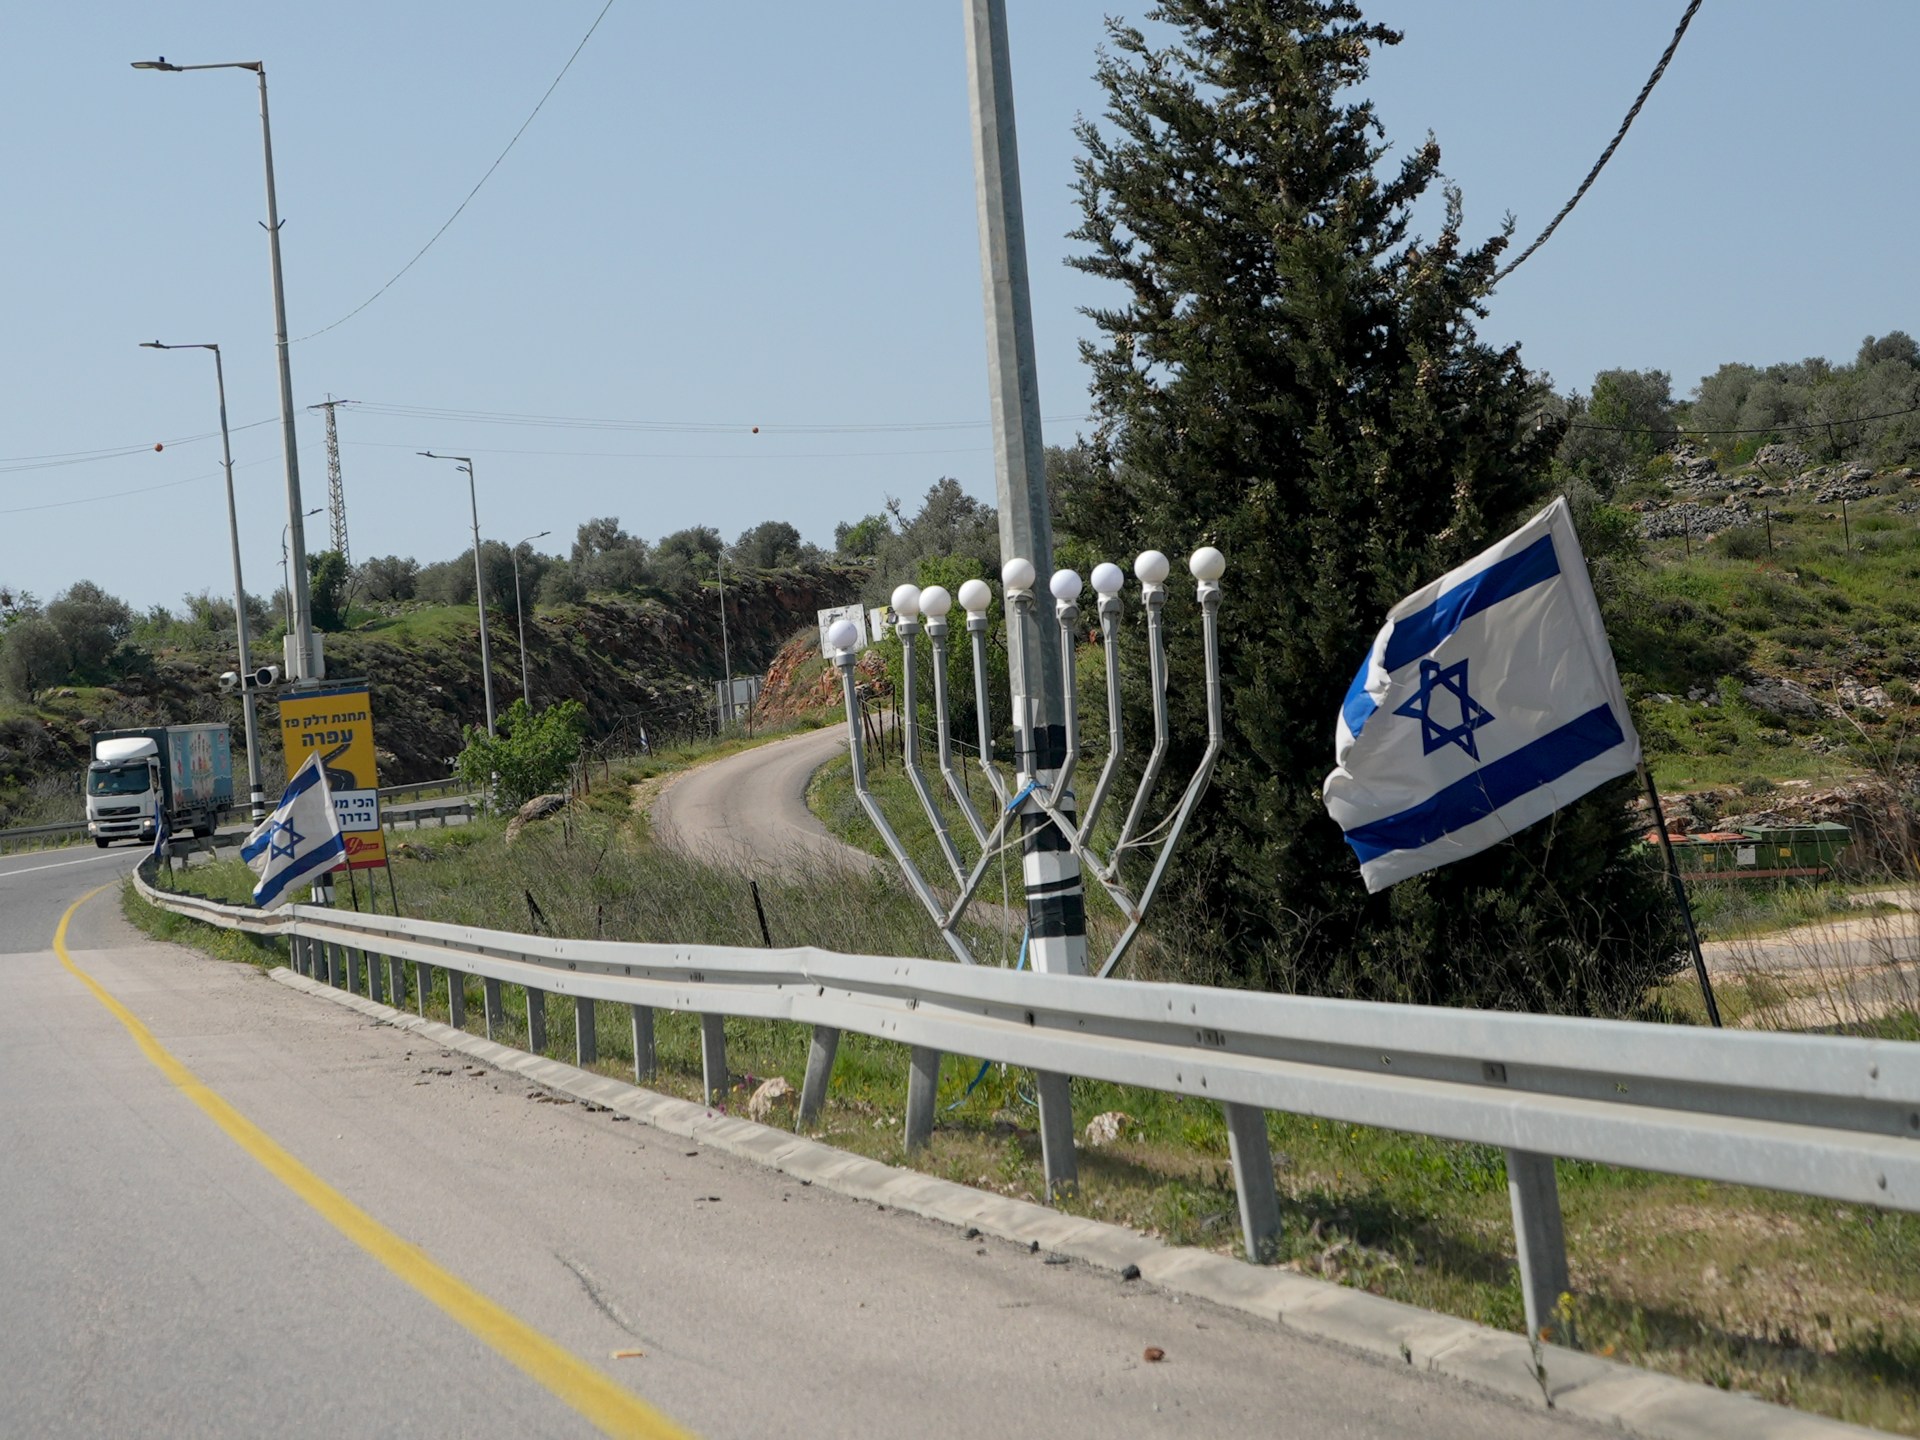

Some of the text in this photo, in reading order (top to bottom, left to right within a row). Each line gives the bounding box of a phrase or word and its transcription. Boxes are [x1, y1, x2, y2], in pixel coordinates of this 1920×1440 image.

[284, 711, 367, 729] תחנת דלק פז
[301, 729, 353, 747] עפרה
[352, 798, 374, 808] הכי
[339, 812, 371, 825] בדרך
